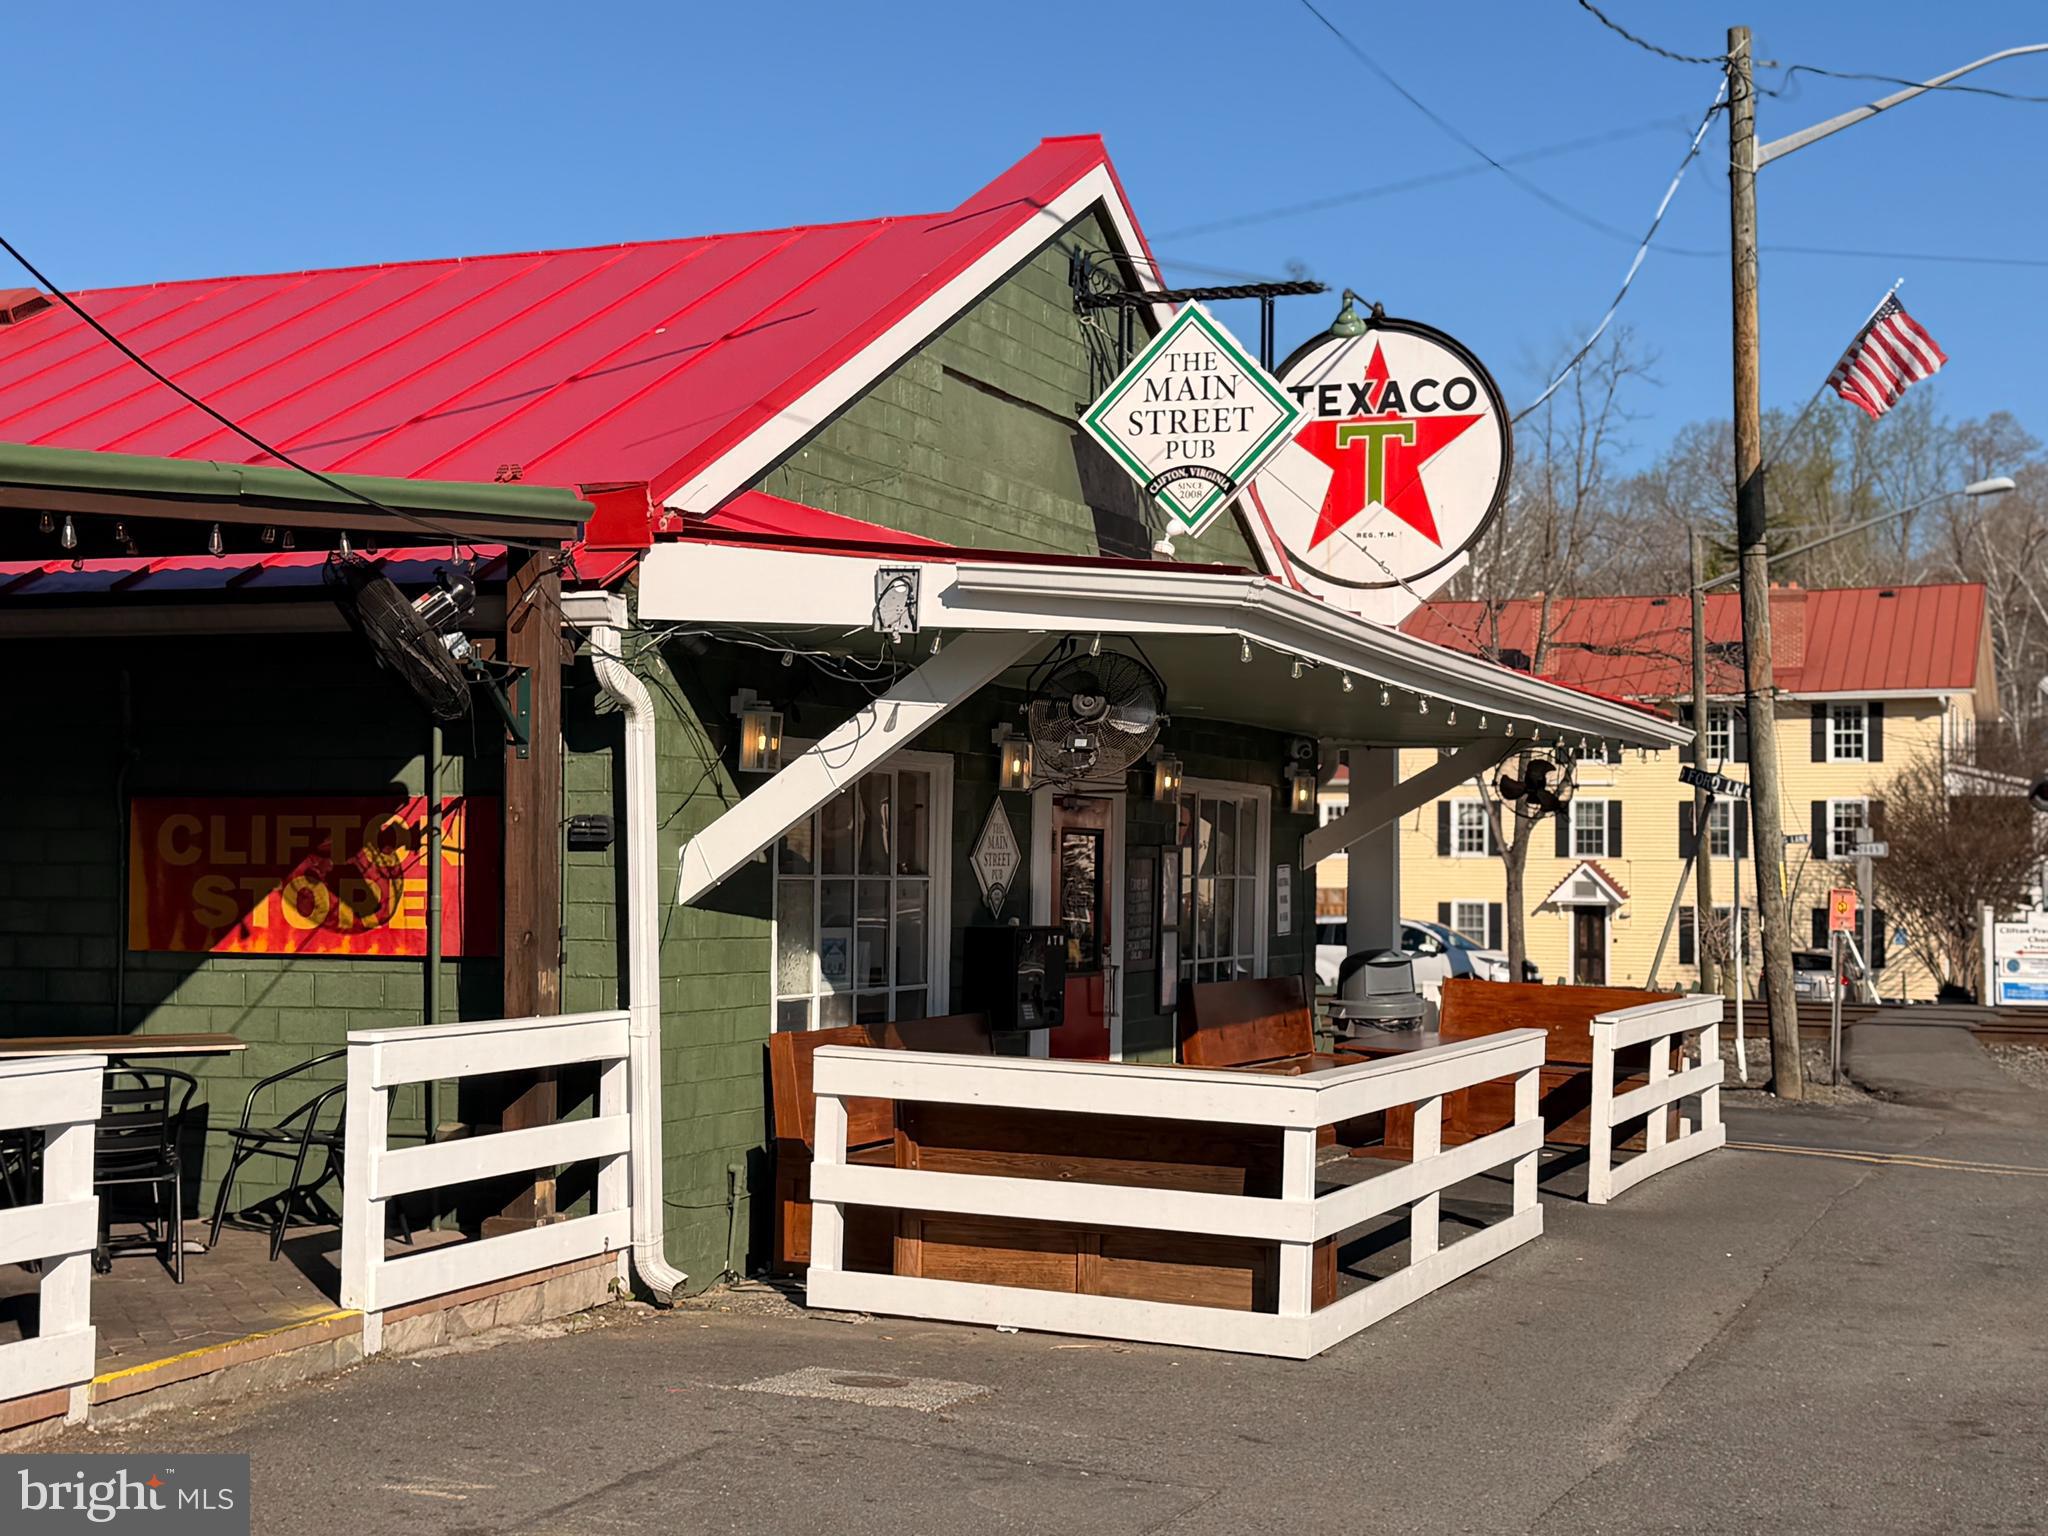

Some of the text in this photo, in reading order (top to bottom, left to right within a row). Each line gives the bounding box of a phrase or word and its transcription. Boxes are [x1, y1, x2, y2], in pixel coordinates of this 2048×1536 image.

[1164, 351, 1218, 373] THE
[1143, 374, 1239, 403] MAIN
[1286, 376, 1477, 418] TEXACO
[1128, 406, 1255, 437] STREET
[1165, 439, 1216, 460] PUB
[1338, 422, 1415, 507] T
[1189, 467, 1231, 491] VIRGINIA
[1180, 490, 1203, 499] 2008
[1725, 780, 1745, 797] LN
[156, 812, 464, 867] CLIFTON
[984, 852, 1010, 867] STREET
[191, 873, 429, 930] STORE
